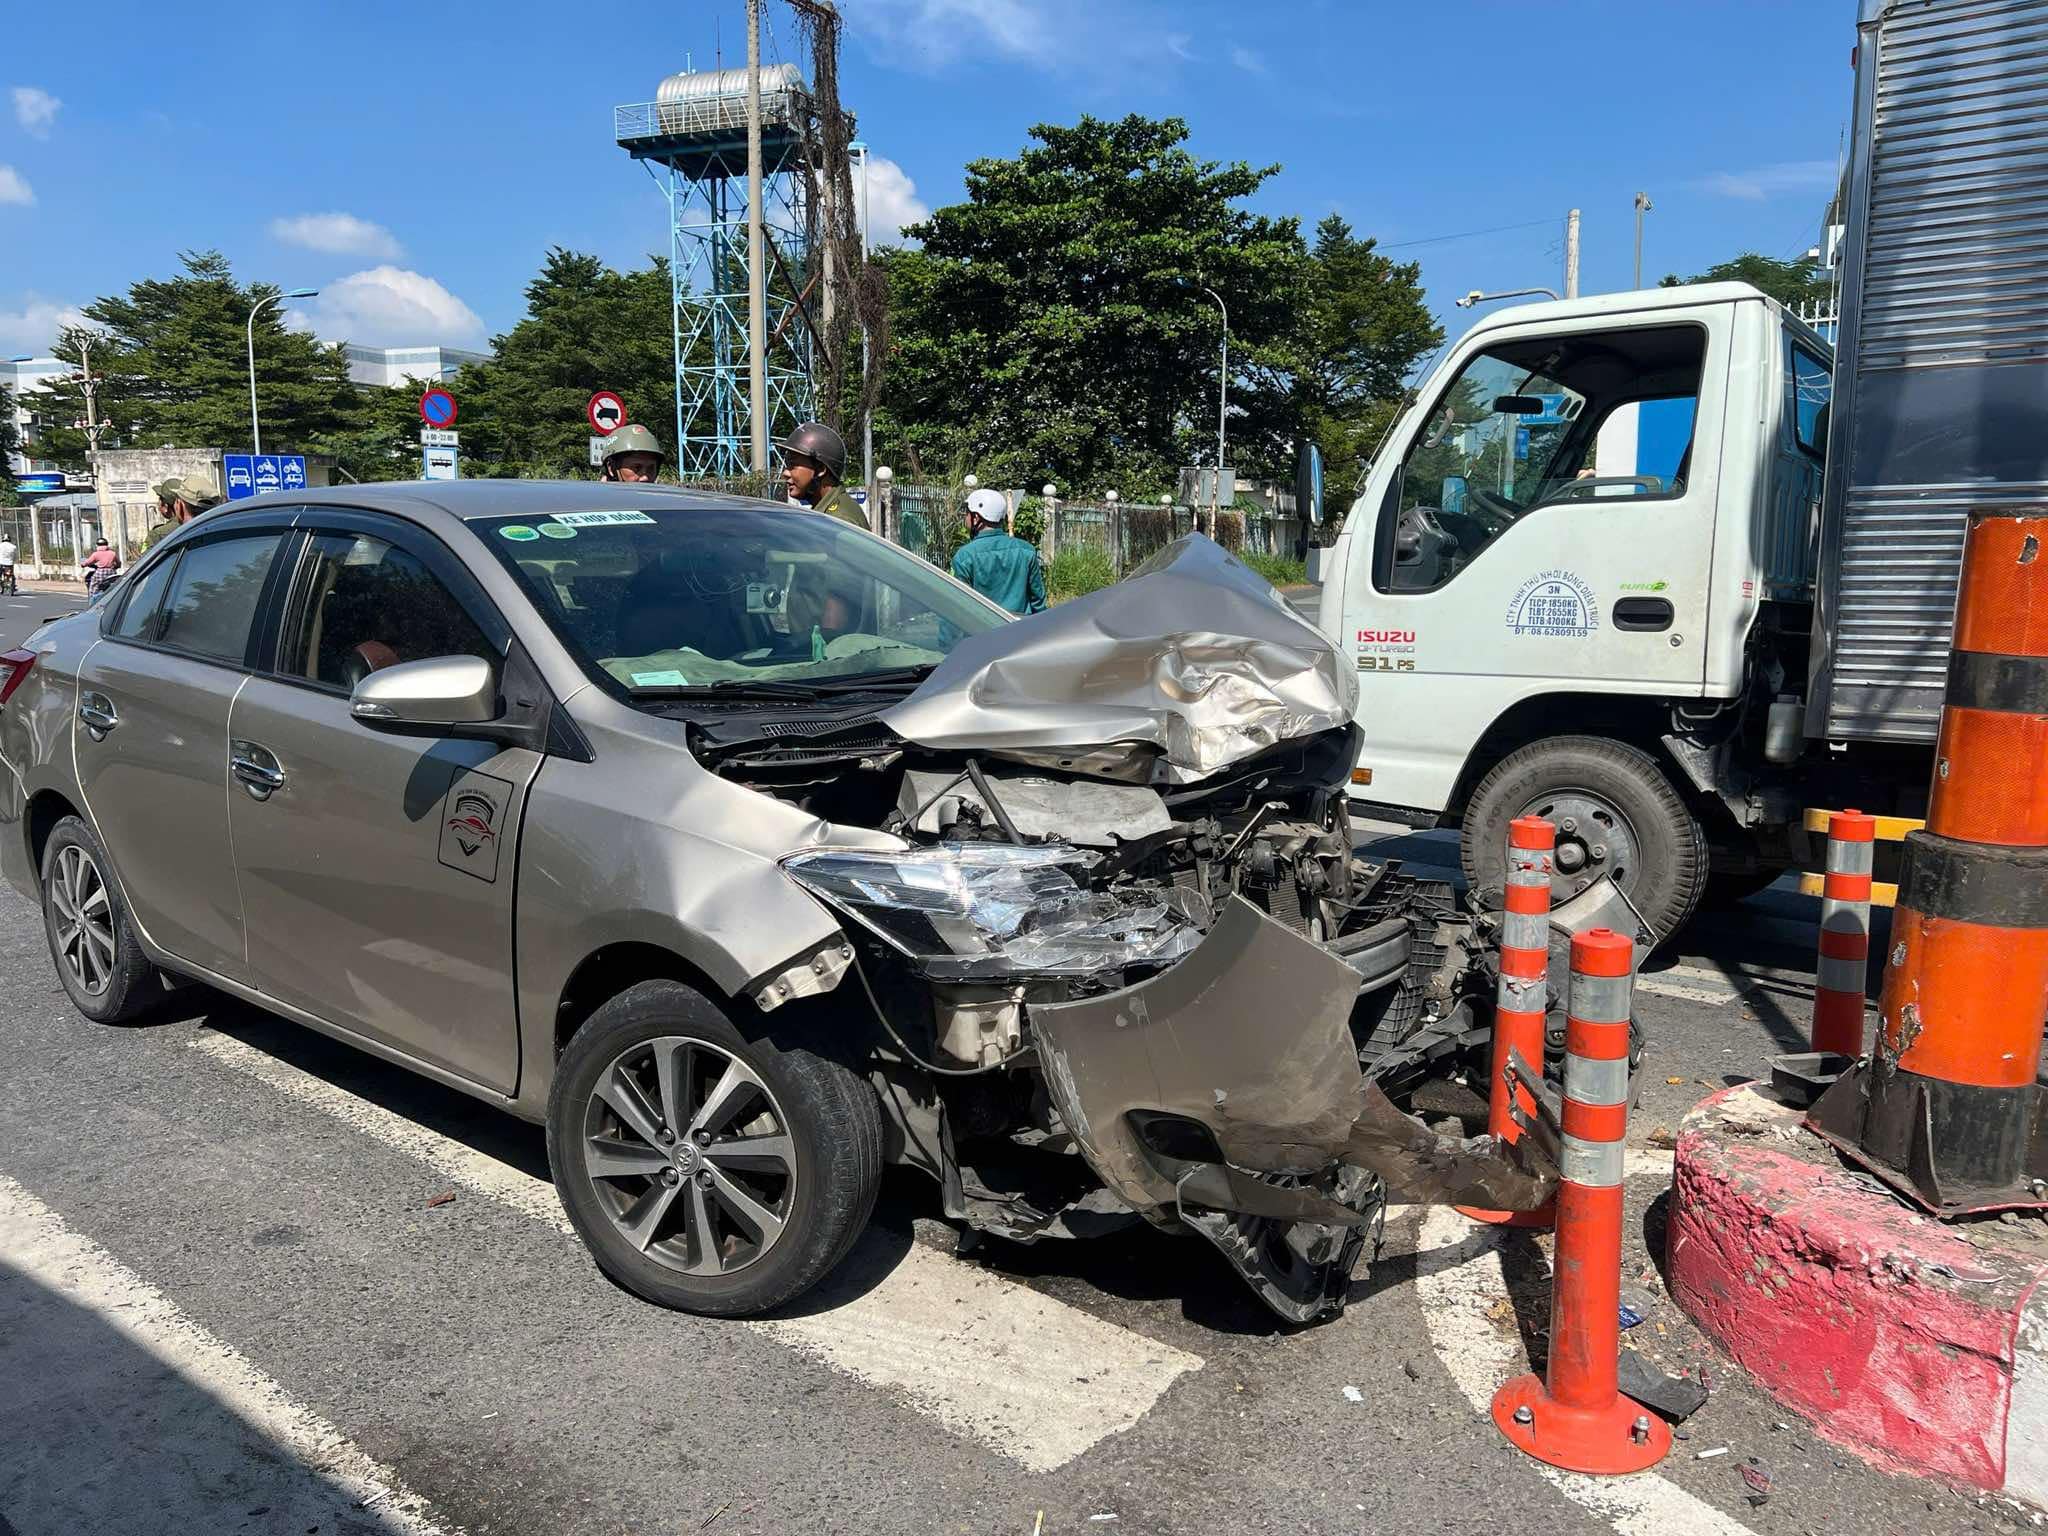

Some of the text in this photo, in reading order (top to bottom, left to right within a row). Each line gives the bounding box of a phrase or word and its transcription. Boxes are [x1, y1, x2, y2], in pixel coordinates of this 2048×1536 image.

[560, 515, 582, 524] XE
[1547, 585, 1561, 595] 3N
[1357, 631, 1416, 643] ISUZU
[1357, 656, 1416, 671] 91 PS
